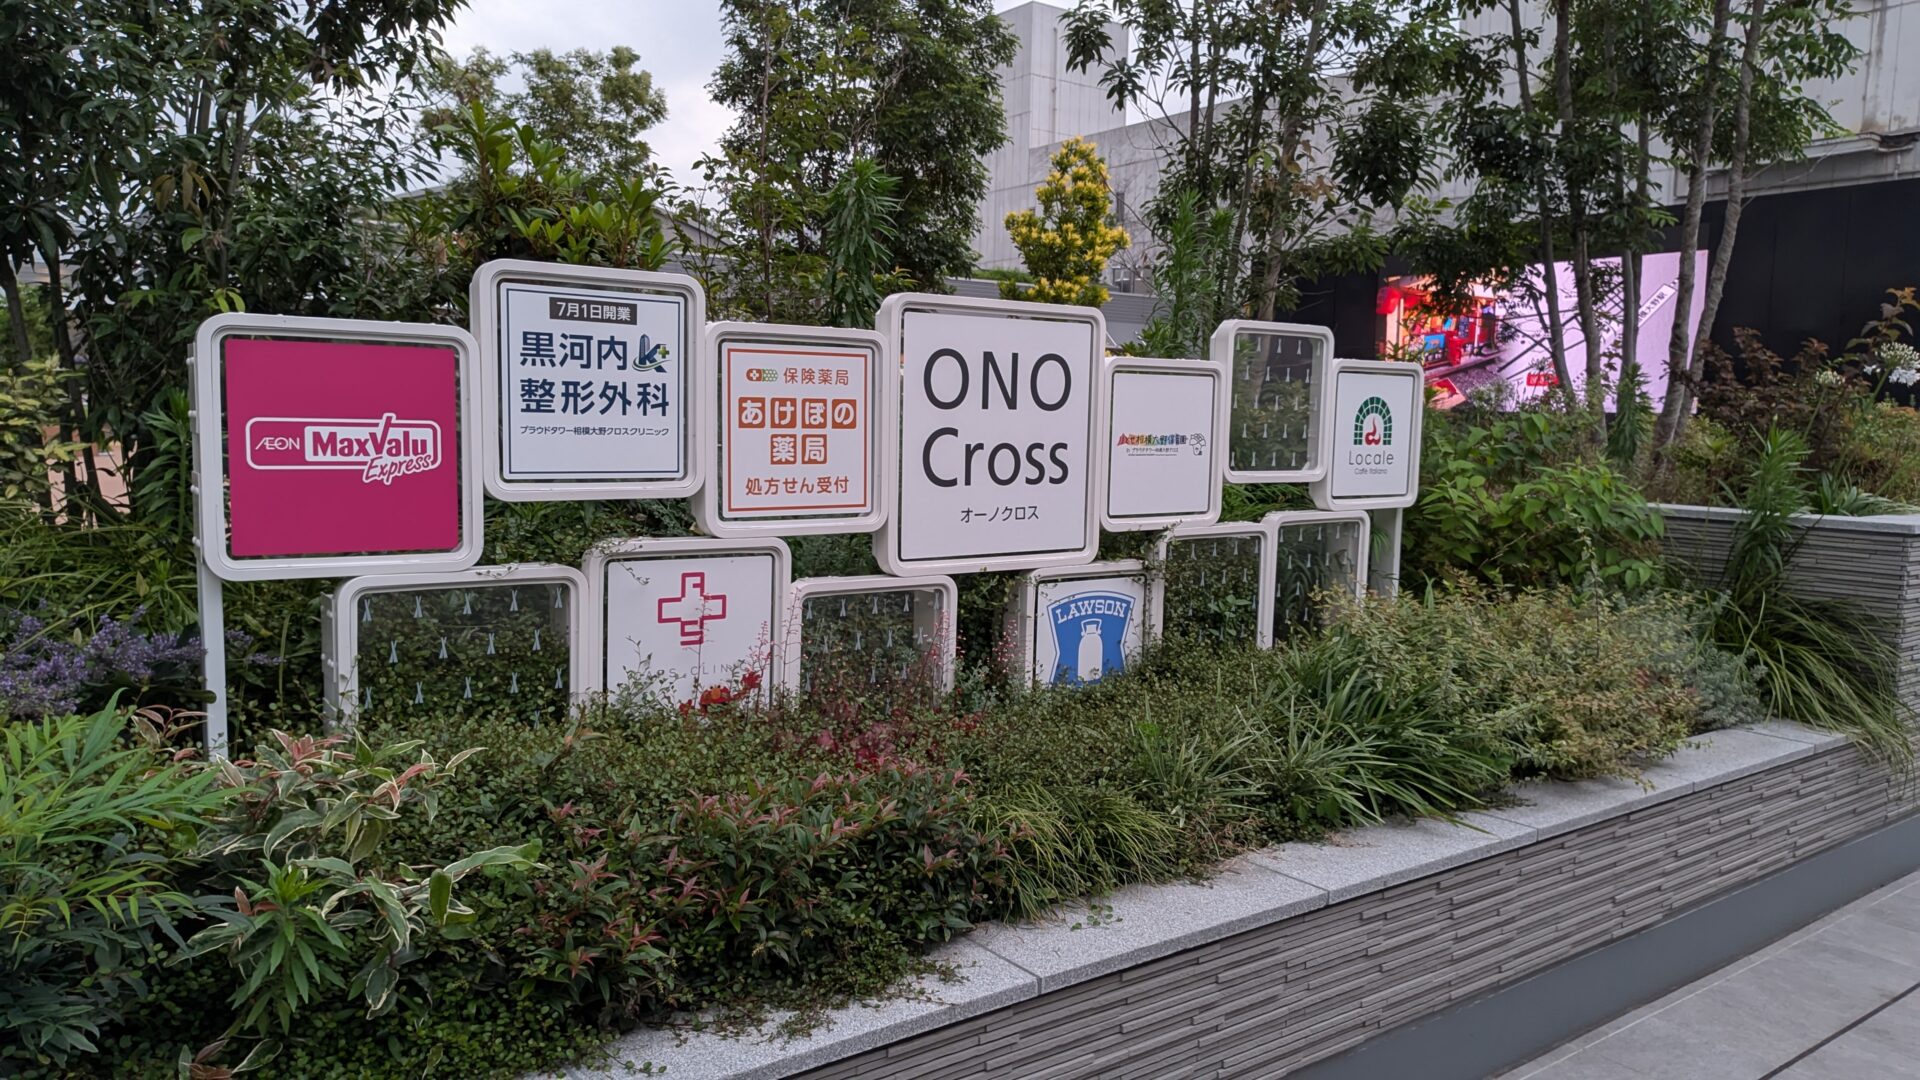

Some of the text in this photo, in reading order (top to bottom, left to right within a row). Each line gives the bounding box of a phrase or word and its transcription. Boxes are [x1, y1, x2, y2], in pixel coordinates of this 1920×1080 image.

[556, 301, 631, 321] 7月1日開業
[520, 331, 627, 370] 黒河内
[783, 367, 849, 385] 保険薬局
[923, 347, 1072, 412] ONO
[520, 378, 669, 416] 整形外科
[740, 399, 855, 426] あけぼの
[312, 415, 428, 457] MaxValu
[520, 424, 669, 436] プラウドタワー相模大野クロスクリニック
[772, 436, 825, 462] 薬局
[922, 427, 1069, 488] Cross
[1348, 450, 1394, 465] Locale
[364, 453, 432, 484] Express
[745, 476, 849, 495] 処方せん受付
[960, 505, 1039, 523] オーノクロス
[1055, 599, 1127, 624] LAWSON
